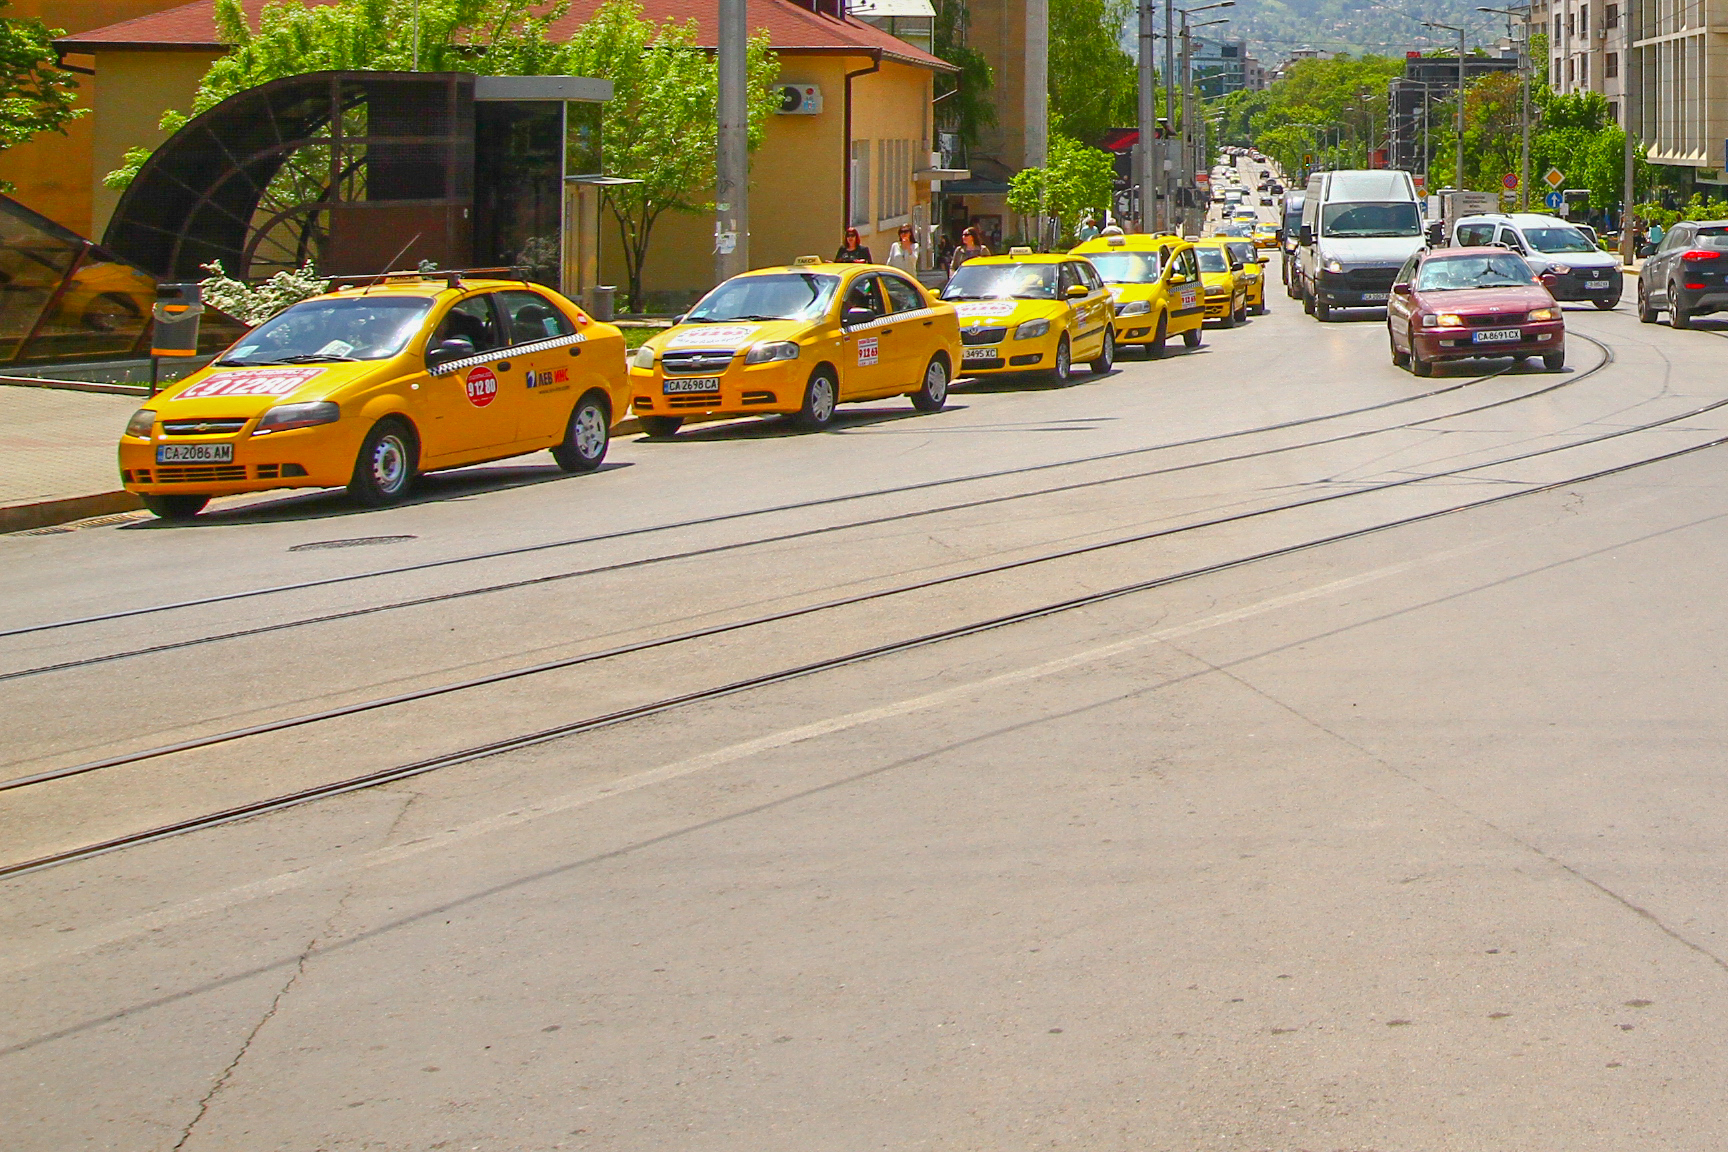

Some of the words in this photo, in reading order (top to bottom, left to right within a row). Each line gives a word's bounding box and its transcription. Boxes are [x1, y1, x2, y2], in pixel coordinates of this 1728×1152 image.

[1477, 332, 1489, 341] CA
[1489, 331, 1508, 340] 8691
[1508, 330, 1519, 339] CX
[965, 349, 983, 358] 3495
[984, 349, 996, 358] XC
[468, 382, 474, 397] 9
[474, 380, 485, 396] 12
[485, 378, 496, 394] 80
[669, 380, 681, 391] CA
[681, 379, 704, 391] 2698
[704, 378, 717, 389] CA
[164, 447, 180, 460] CA
[182, 445, 210, 460] 2086
[213, 445, 230, 459] AM
